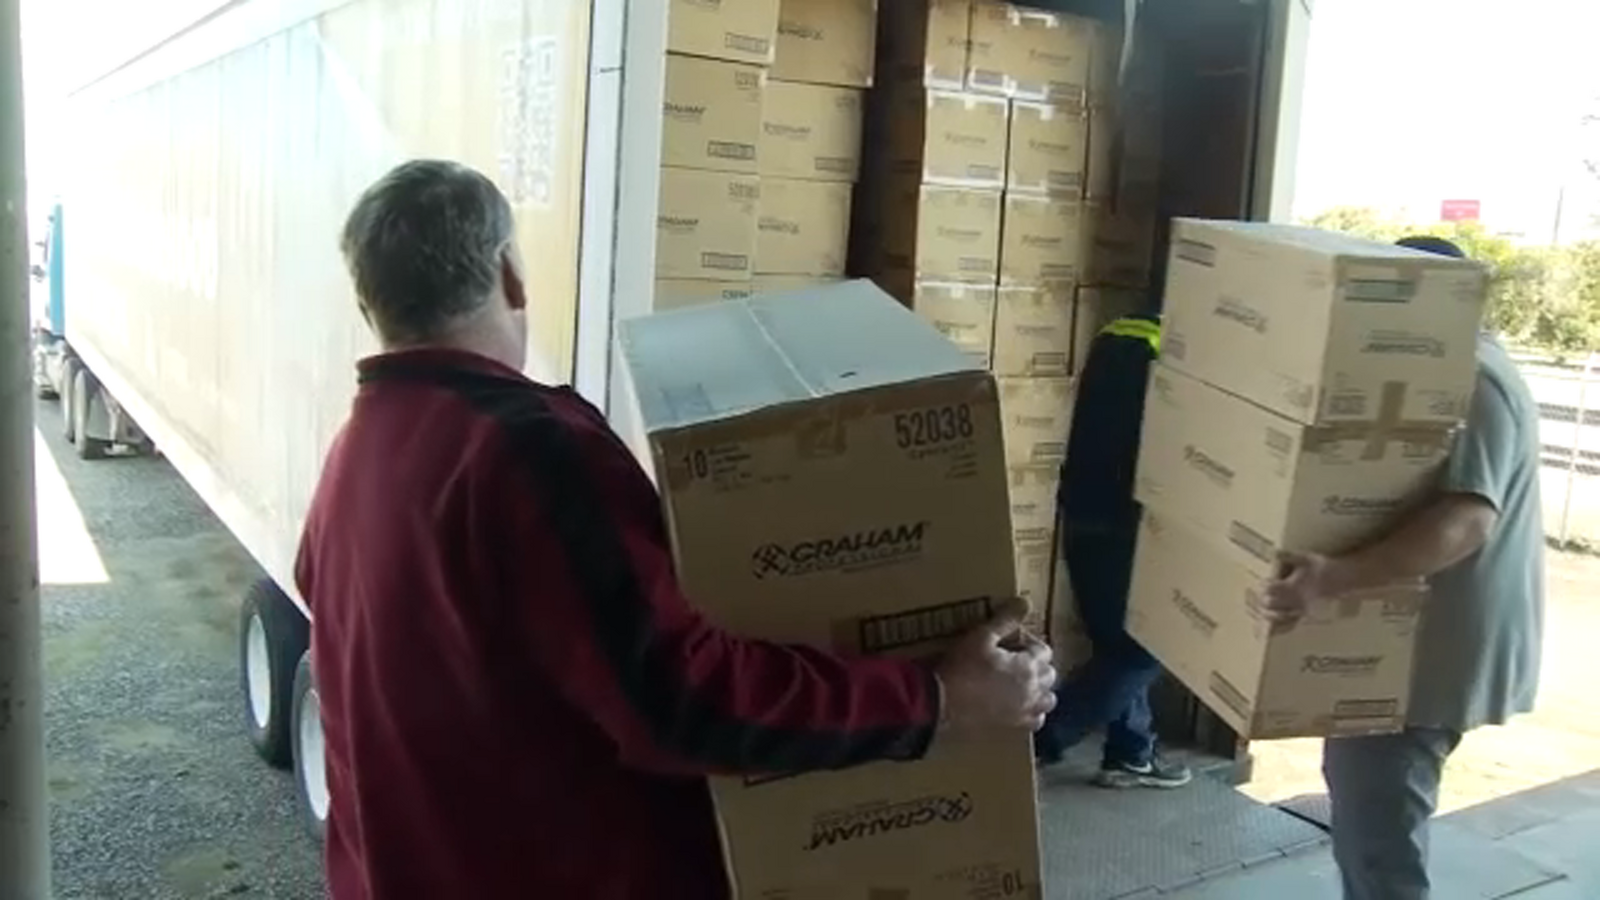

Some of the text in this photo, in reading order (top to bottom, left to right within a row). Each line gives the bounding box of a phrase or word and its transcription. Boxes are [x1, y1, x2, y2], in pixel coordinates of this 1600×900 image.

[894, 402, 973, 449] 52038
[683, 449, 708, 480] 10
[789, 521, 925, 563] GRAHAM
[810, 807, 936, 851] GRAHAM
[1002, 868, 1025, 896] 10
